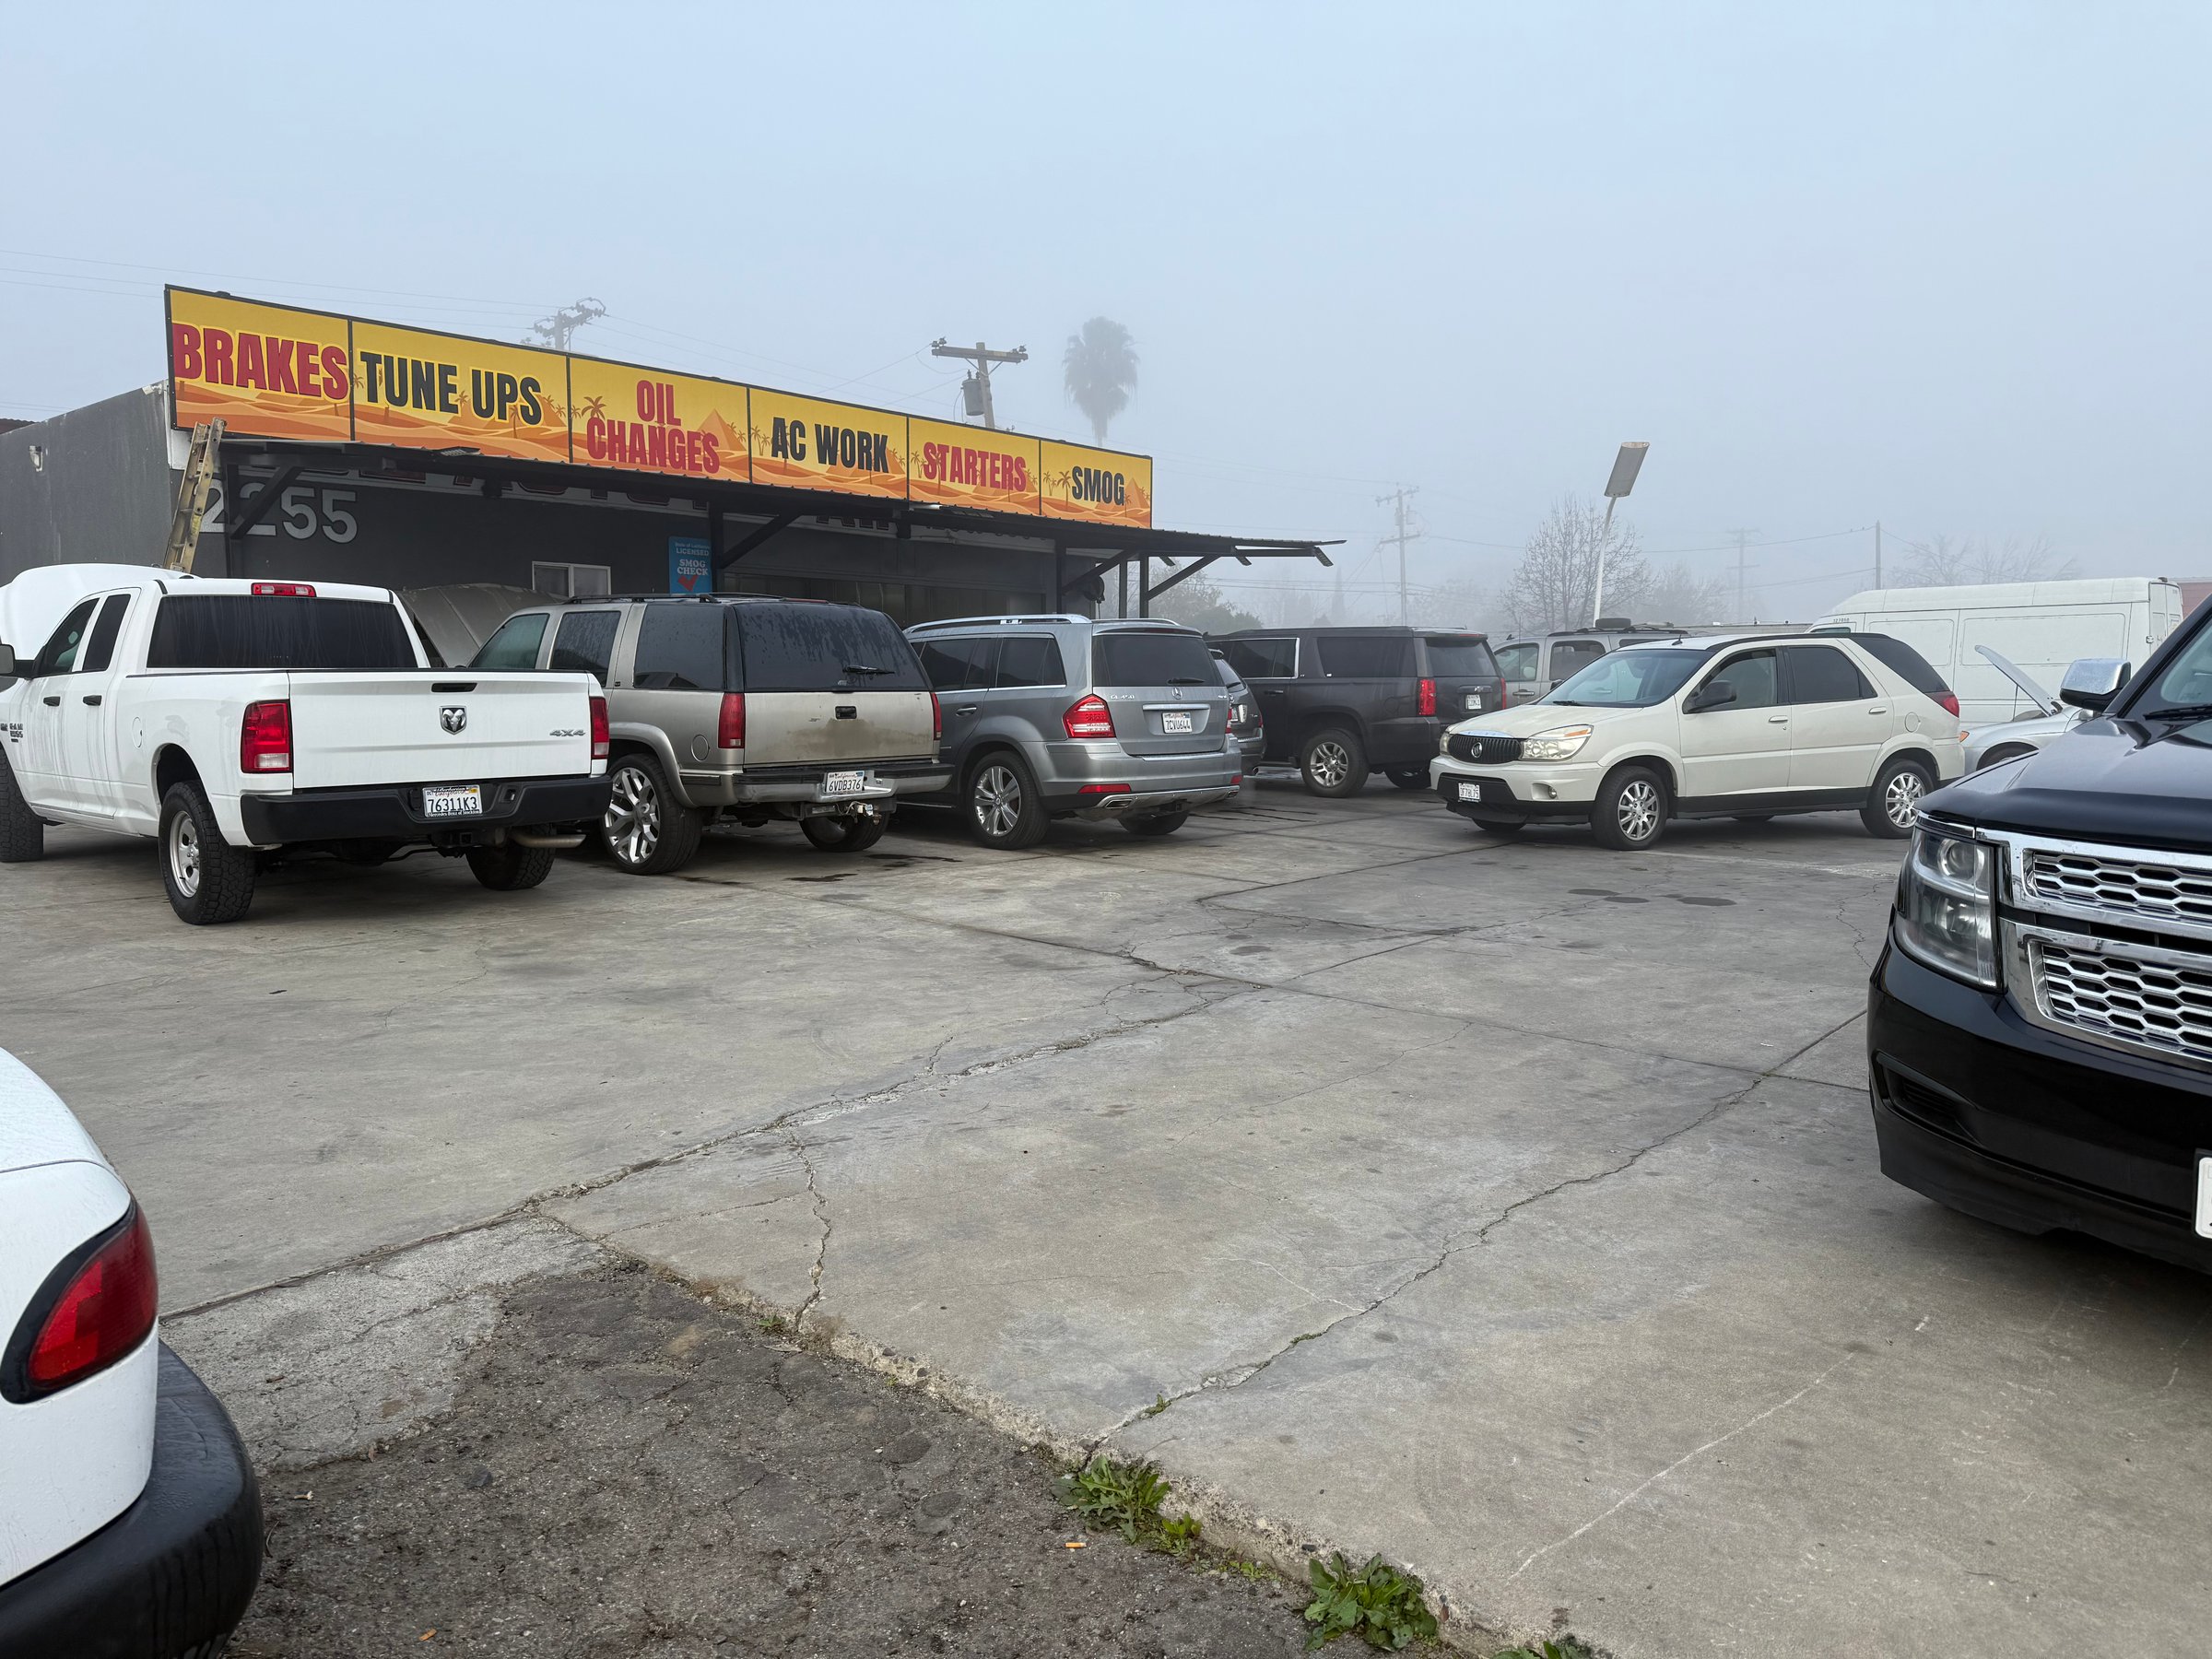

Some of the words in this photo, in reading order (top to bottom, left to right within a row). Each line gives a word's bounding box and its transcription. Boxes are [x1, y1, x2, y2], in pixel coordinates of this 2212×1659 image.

[172, 323, 349, 400] BRAKES
[360, 351, 459, 414] TUNE
[471, 369, 542, 426] UPS
[636, 380, 681, 427] OIL
[586, 417, 720, 474] CHANGES
[771, 417, 806, 462] AC
[814, 423, 889, 474] WORK
[923, 441, 1027, 492] STARTERS
[1071, 465, 1124, 506] SMOG
[676, 547, 710, 556] LICENSED
[677, 567, 709, 575] CHECK
[678, 559, 706, 568] SMOG
[428, 796, 477, 813] 76311K3
[829, 779, 862, 792] 6VDB376
